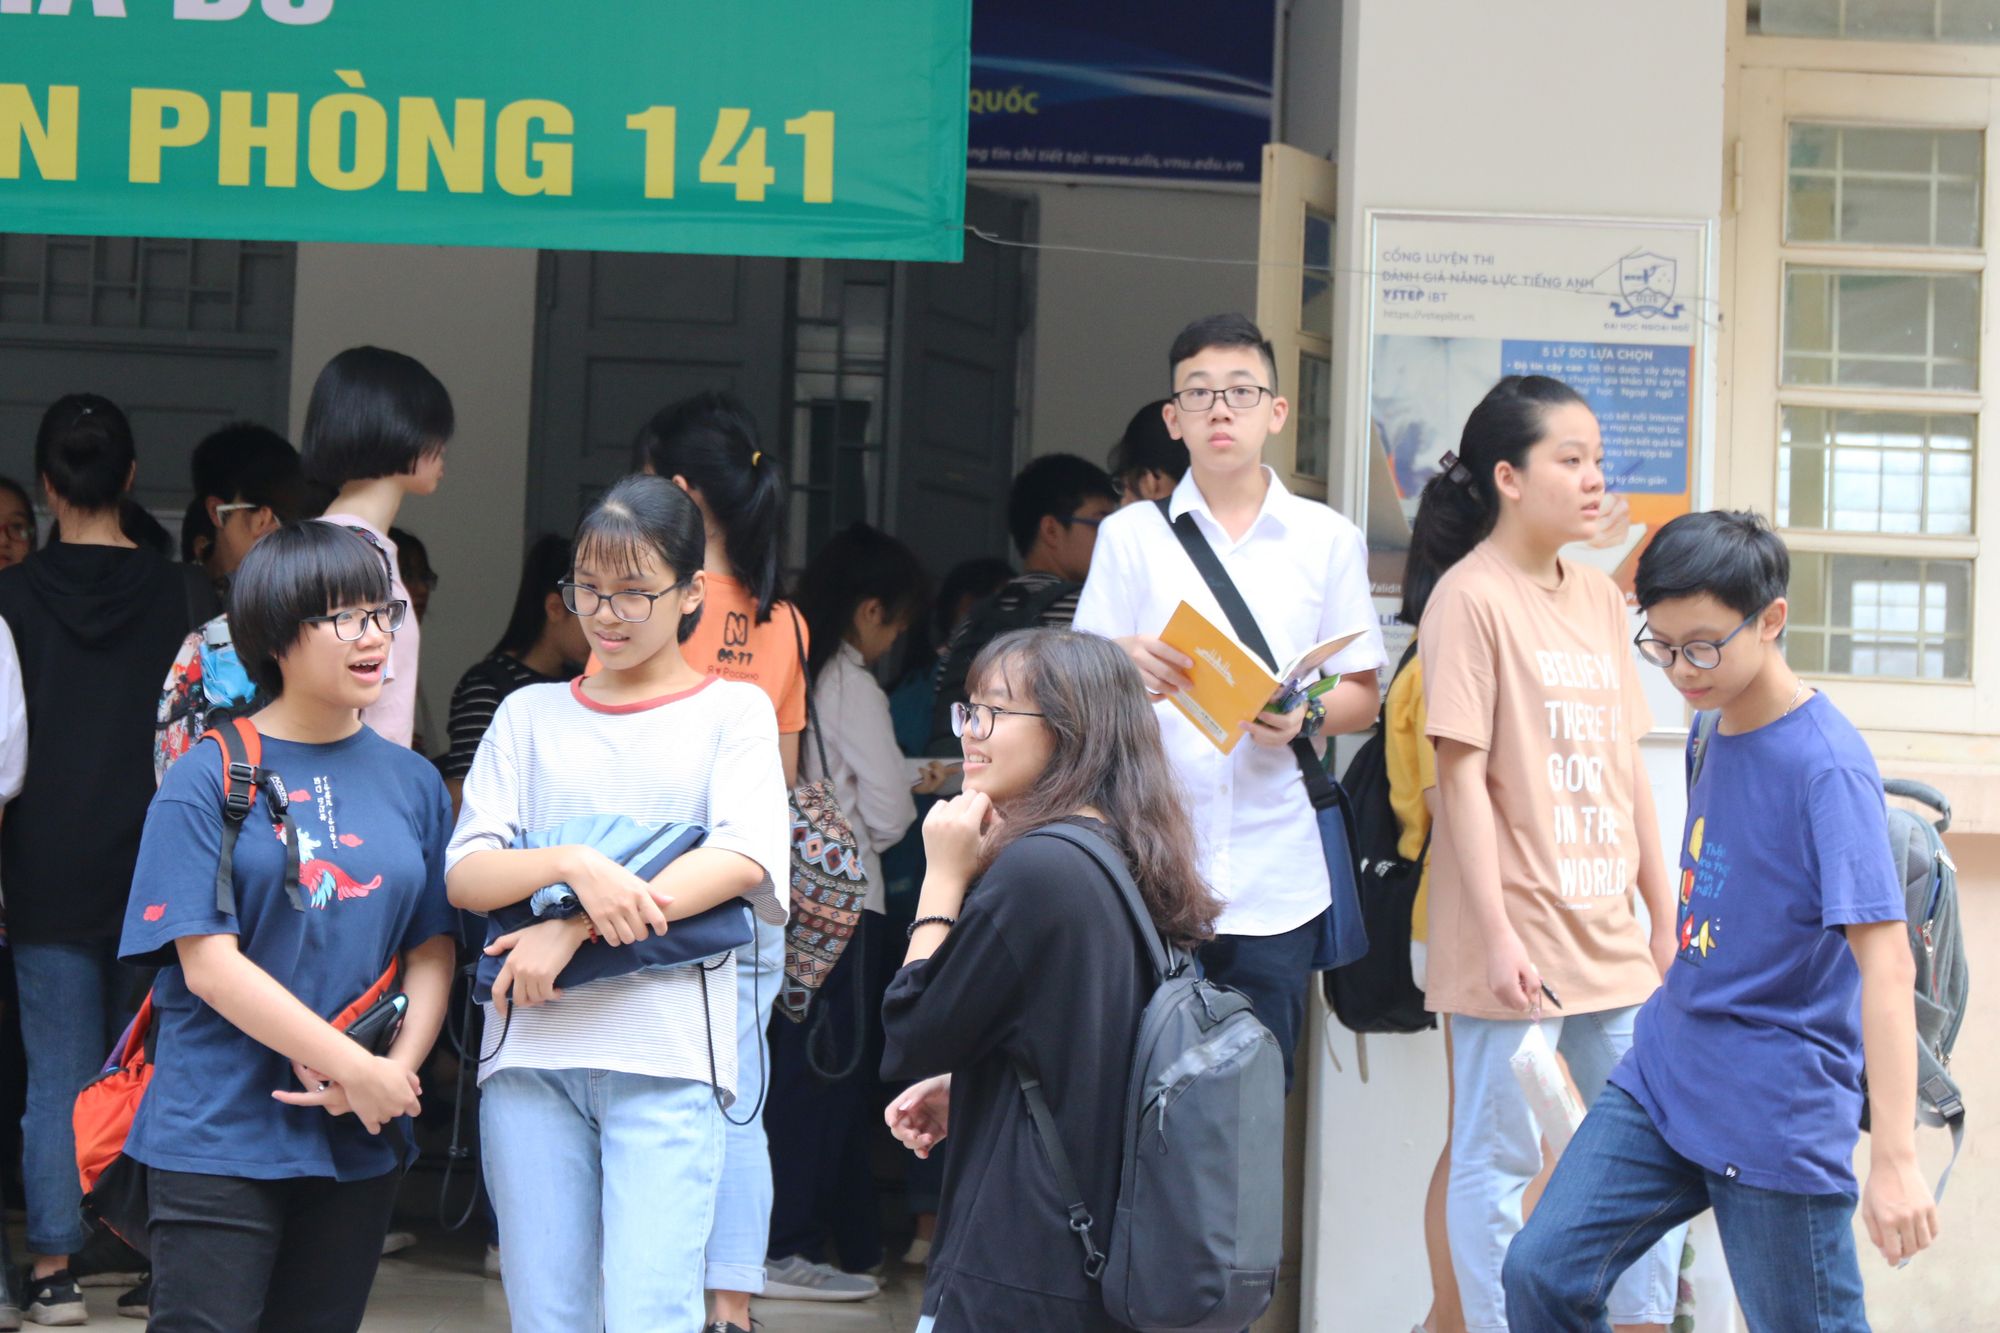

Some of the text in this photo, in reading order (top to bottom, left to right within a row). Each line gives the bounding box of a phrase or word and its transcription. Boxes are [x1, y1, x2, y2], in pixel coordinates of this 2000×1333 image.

[0, 69, 835, 204] N PHÒNG 141
[991, 147, 1011, 162] tin
[1473, 253, 1495, 266] THI
[1565, 277, 1595, 290] ANH
[1617, 349, 1654, 363] CHỌN
[1544, 700, 1606, 743] THERE
[1553, 805, 1577, 845] IN
[1556, 856, 1628, 898] WORLD
